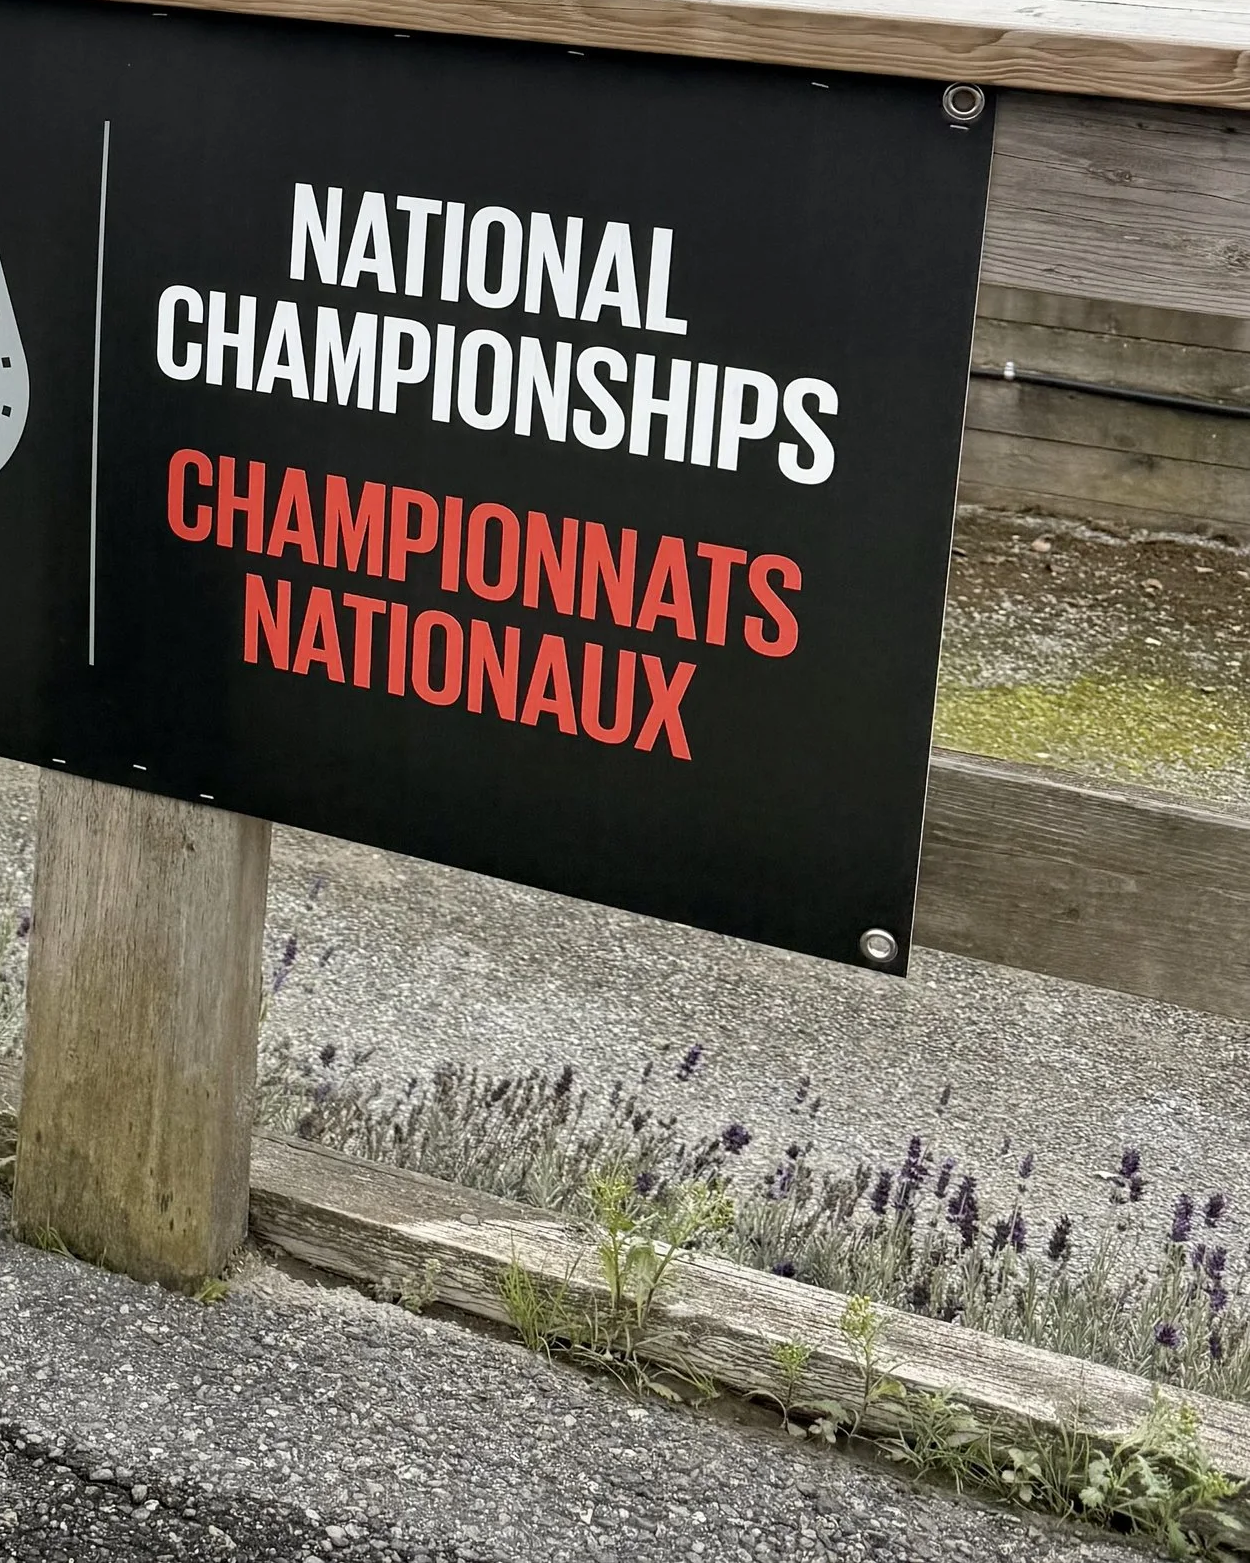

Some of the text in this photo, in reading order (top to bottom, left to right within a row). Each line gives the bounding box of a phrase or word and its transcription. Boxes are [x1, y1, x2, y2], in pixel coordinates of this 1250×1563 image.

[290, 183, 687, 335] NATIONAL
[157, 285, 838, 484] CHAMPIONSHIPS
[168, 449, 800, 657] CHAMPIONNATS
[244, 575, 695, 760] NATIONAUX
